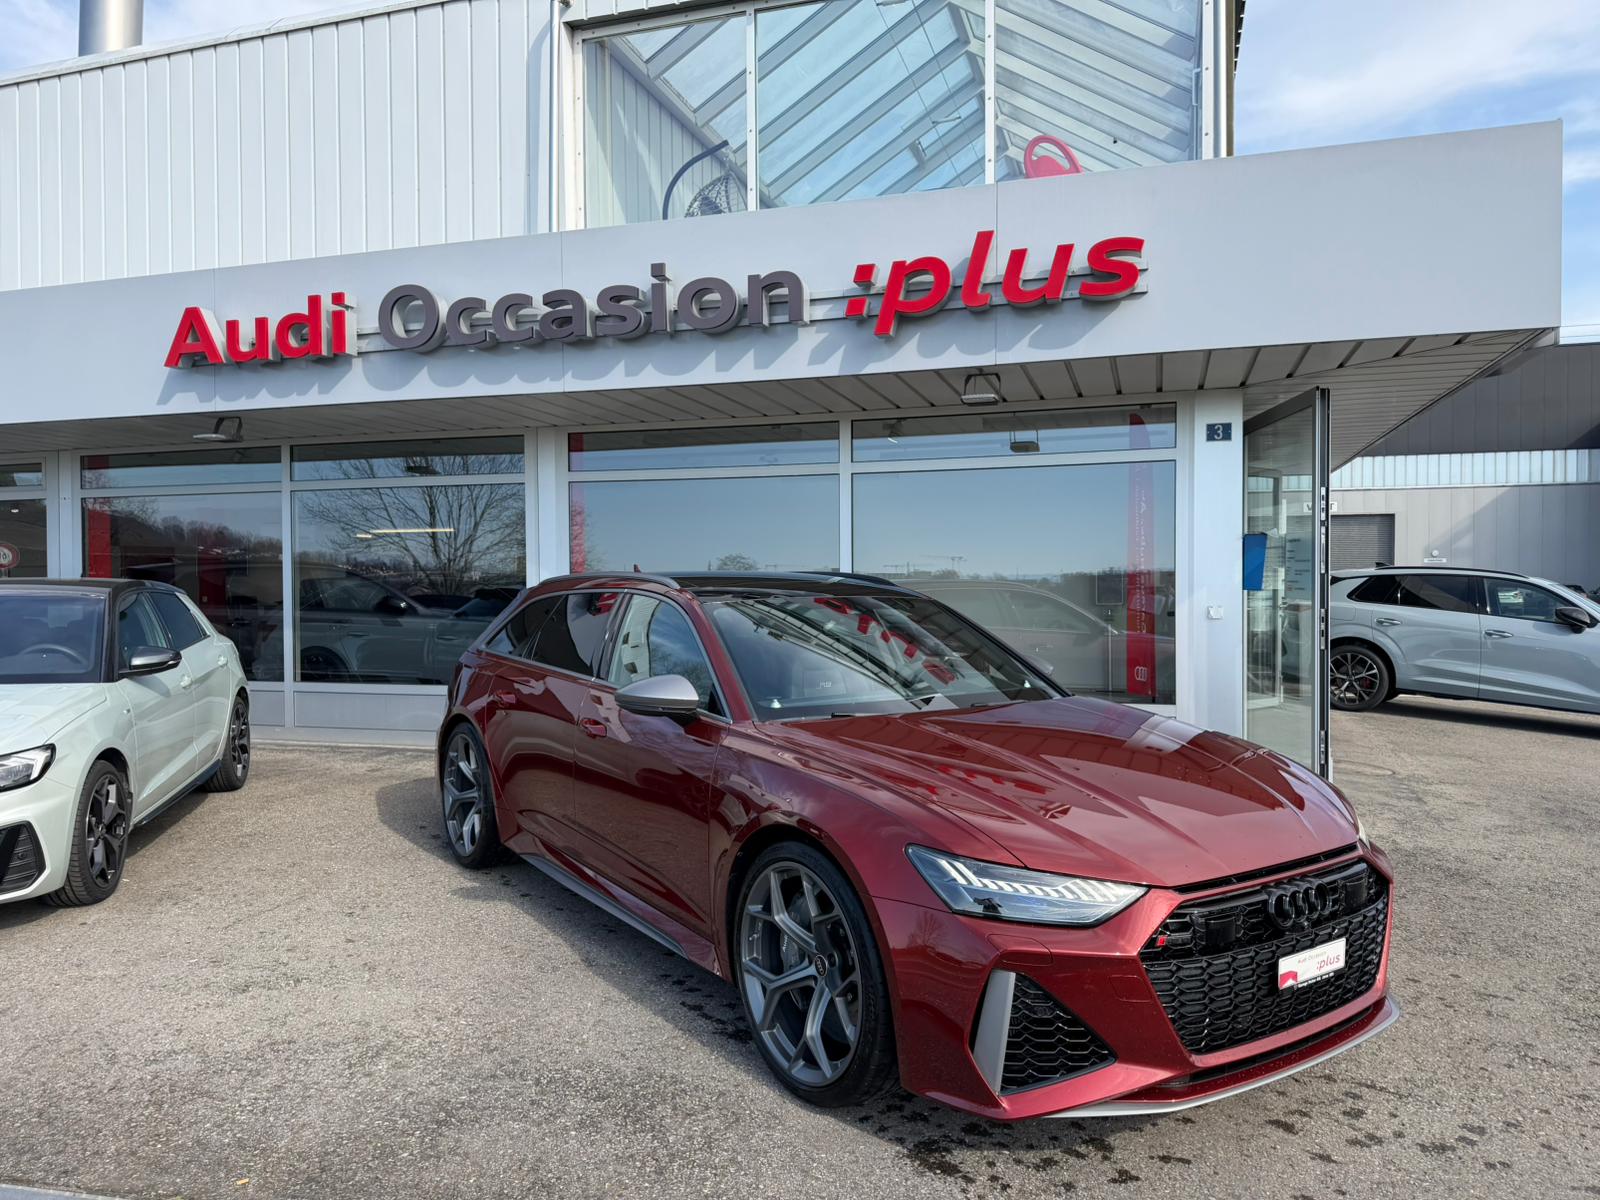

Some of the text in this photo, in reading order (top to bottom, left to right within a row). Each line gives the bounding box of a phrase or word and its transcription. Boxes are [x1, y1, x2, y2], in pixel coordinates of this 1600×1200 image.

[165, 230, 1146, 369] Audi Occasion :plus
[1214, 425, 1223, 440] 3
